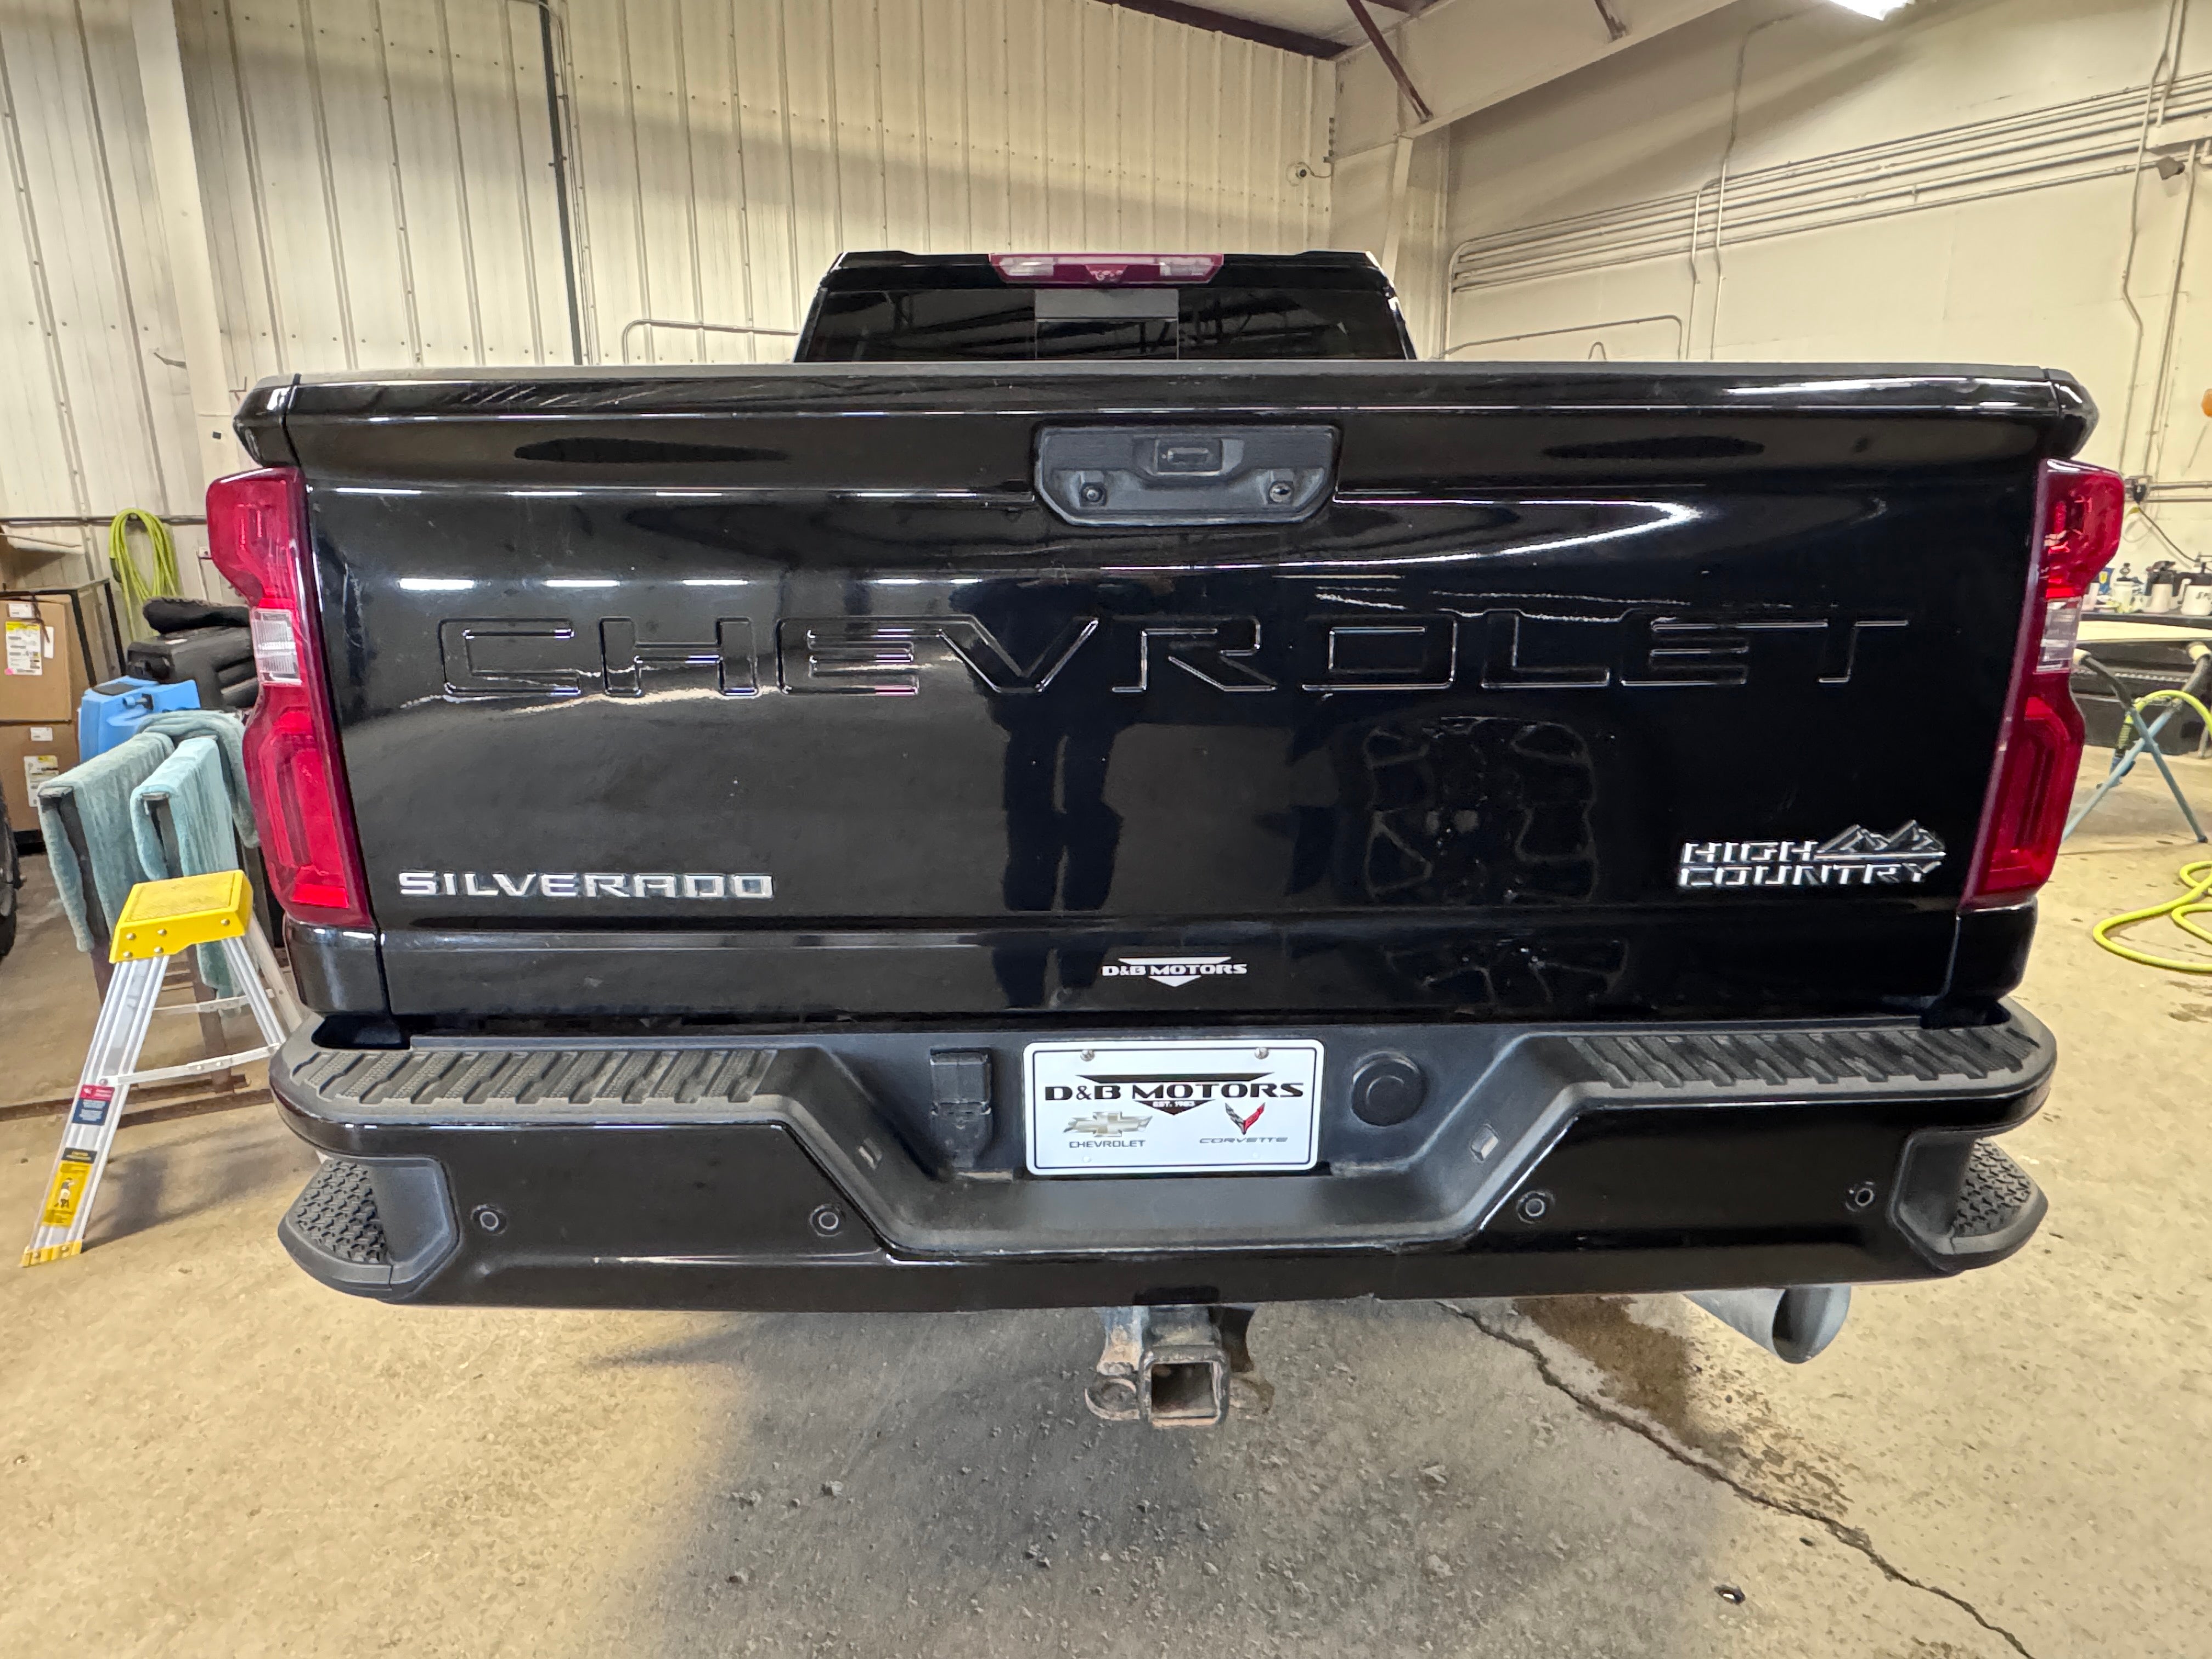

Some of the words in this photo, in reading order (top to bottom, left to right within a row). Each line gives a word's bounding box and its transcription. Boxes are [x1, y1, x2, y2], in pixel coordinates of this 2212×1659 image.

[439, 614, 1909, 697] CHEVROLET
[1682, 841, 1819, 862] HIGH
[399, 871, 774, 898] SILVERADO
[1679, 862, 1942, 886] COUNTRY
[1102, 965, 1147, 976] D&B
[1150, 963, 1248, 975] MOTORS
[1045, 1085, 1121, 1101] D&B
[1132, 1082, 1304, 1099] MOTORS
[1069, 1140, 1146, 1148] CHEVROLET
